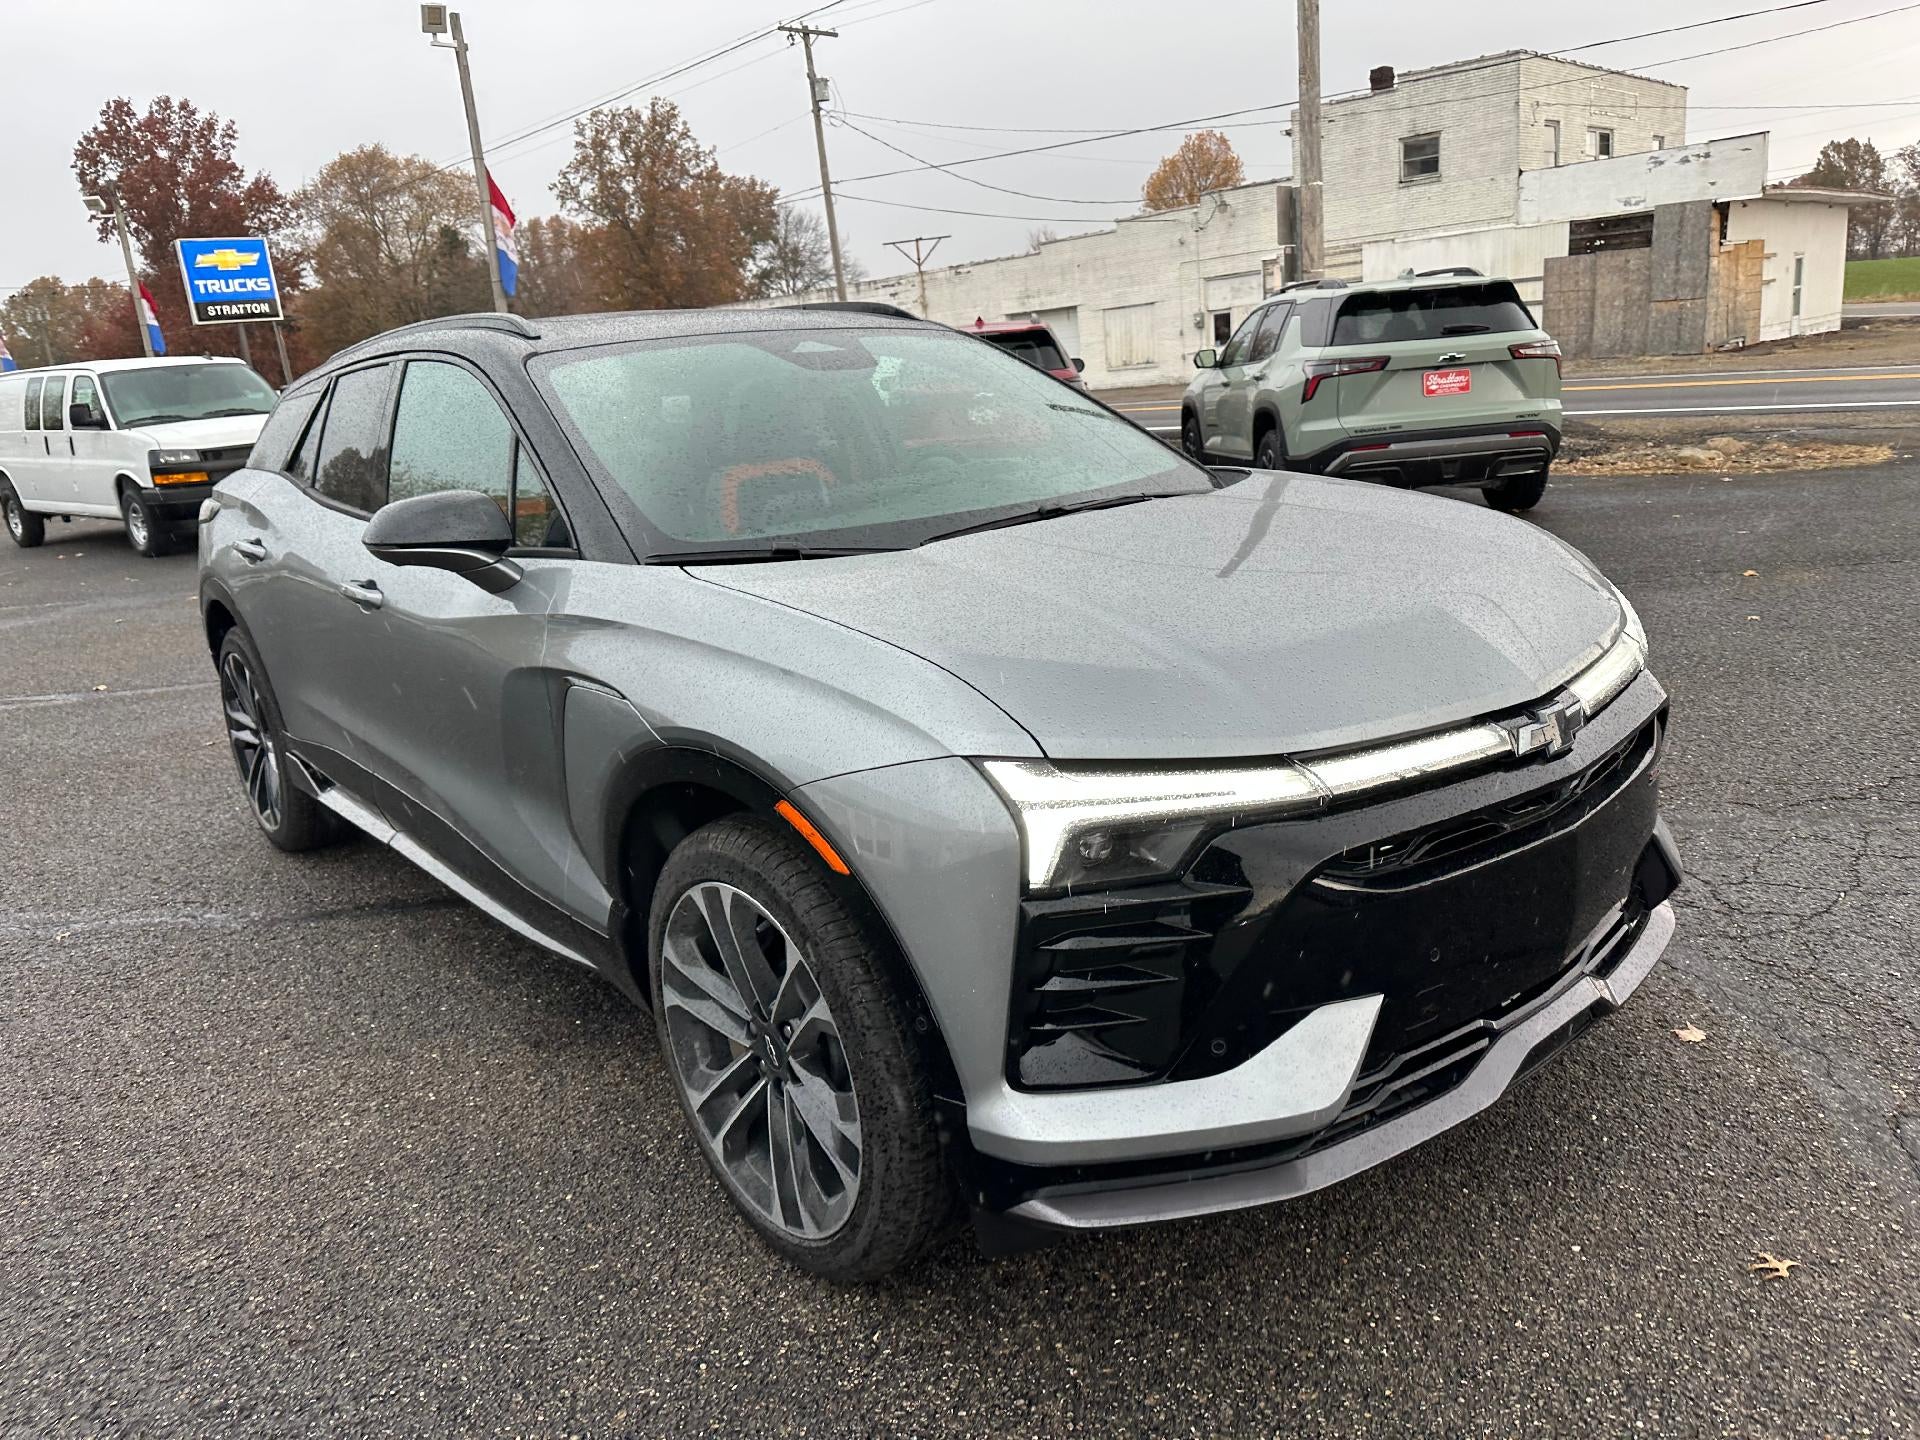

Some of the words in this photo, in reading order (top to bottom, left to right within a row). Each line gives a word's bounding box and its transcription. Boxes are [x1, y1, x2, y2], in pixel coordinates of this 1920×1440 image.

[194, 278, 270, 294] TRUCKS
[207, 303, 270, 316] STRATTON
[1427, 372, 1469, 386] Stratton
